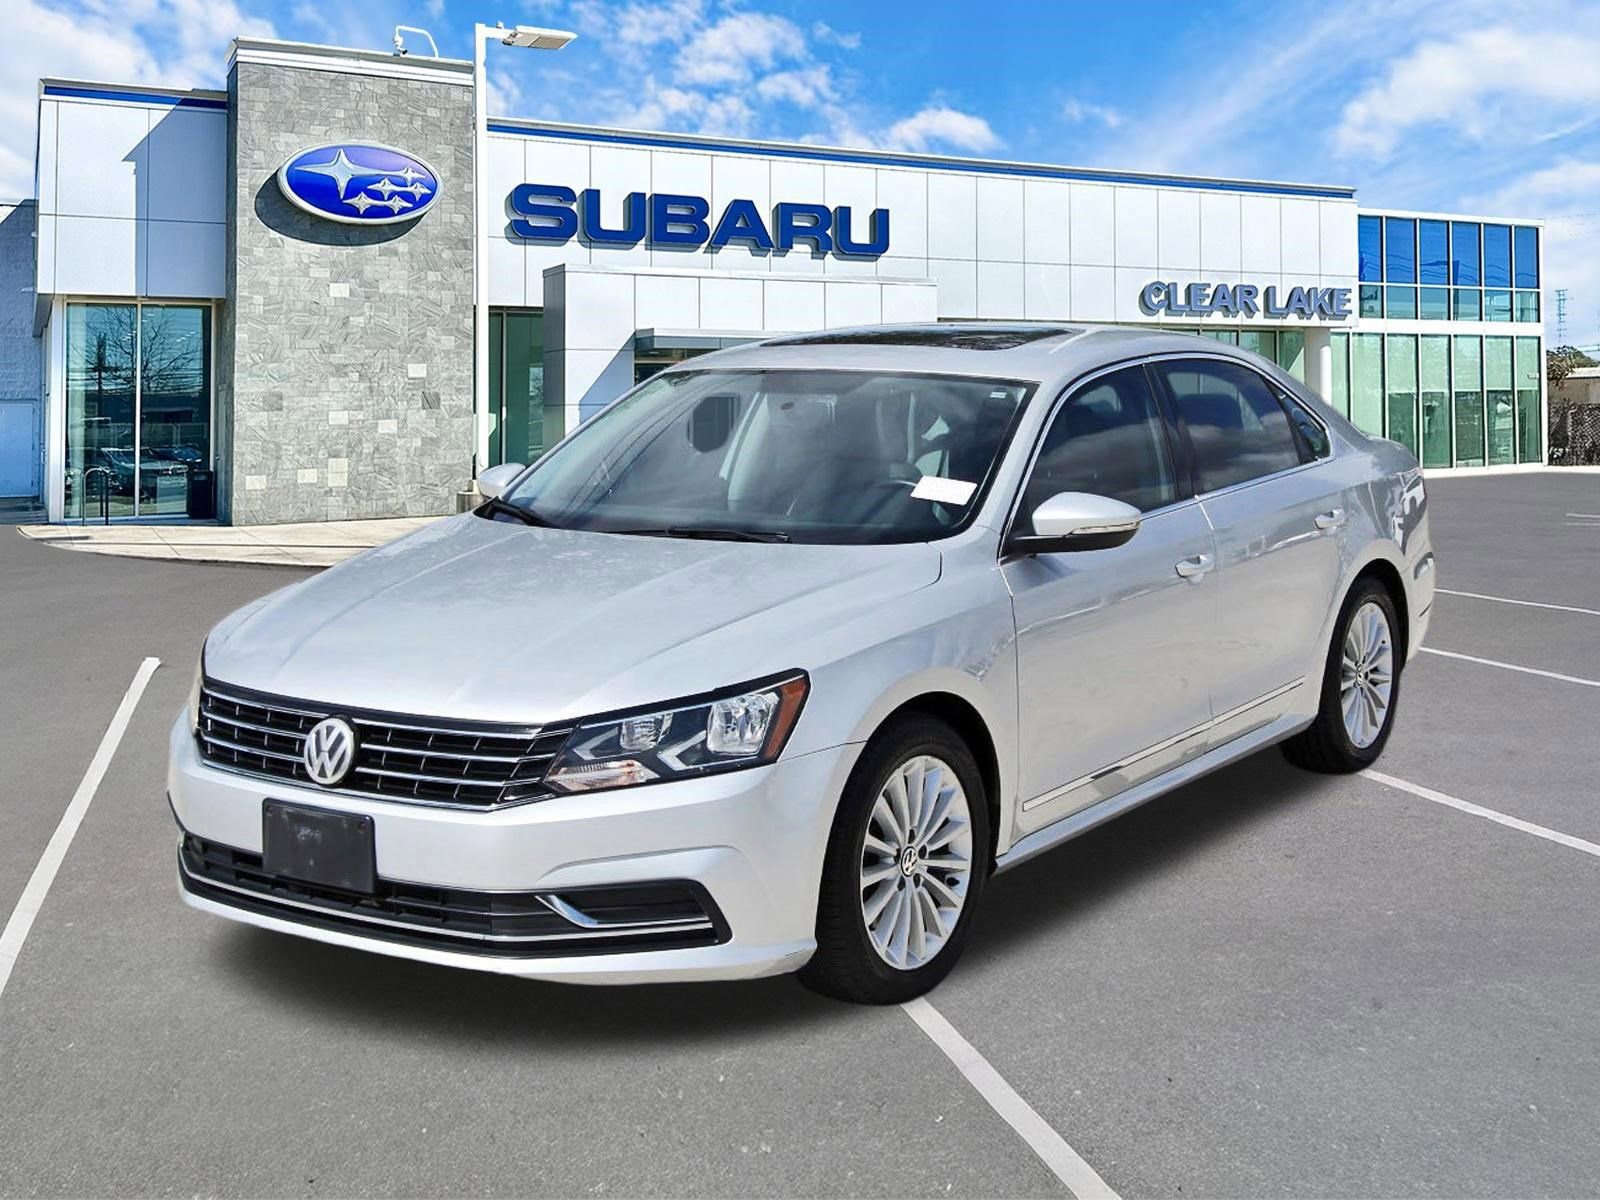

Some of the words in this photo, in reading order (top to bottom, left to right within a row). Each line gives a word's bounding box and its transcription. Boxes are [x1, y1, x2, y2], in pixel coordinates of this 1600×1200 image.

[506, 183, 890, 260] SUBARU
[1140, 281, 1260, 317] CLEAR
[1263, 286, 1353, 320] LAKE
[304, 718, 354, 784] VW
